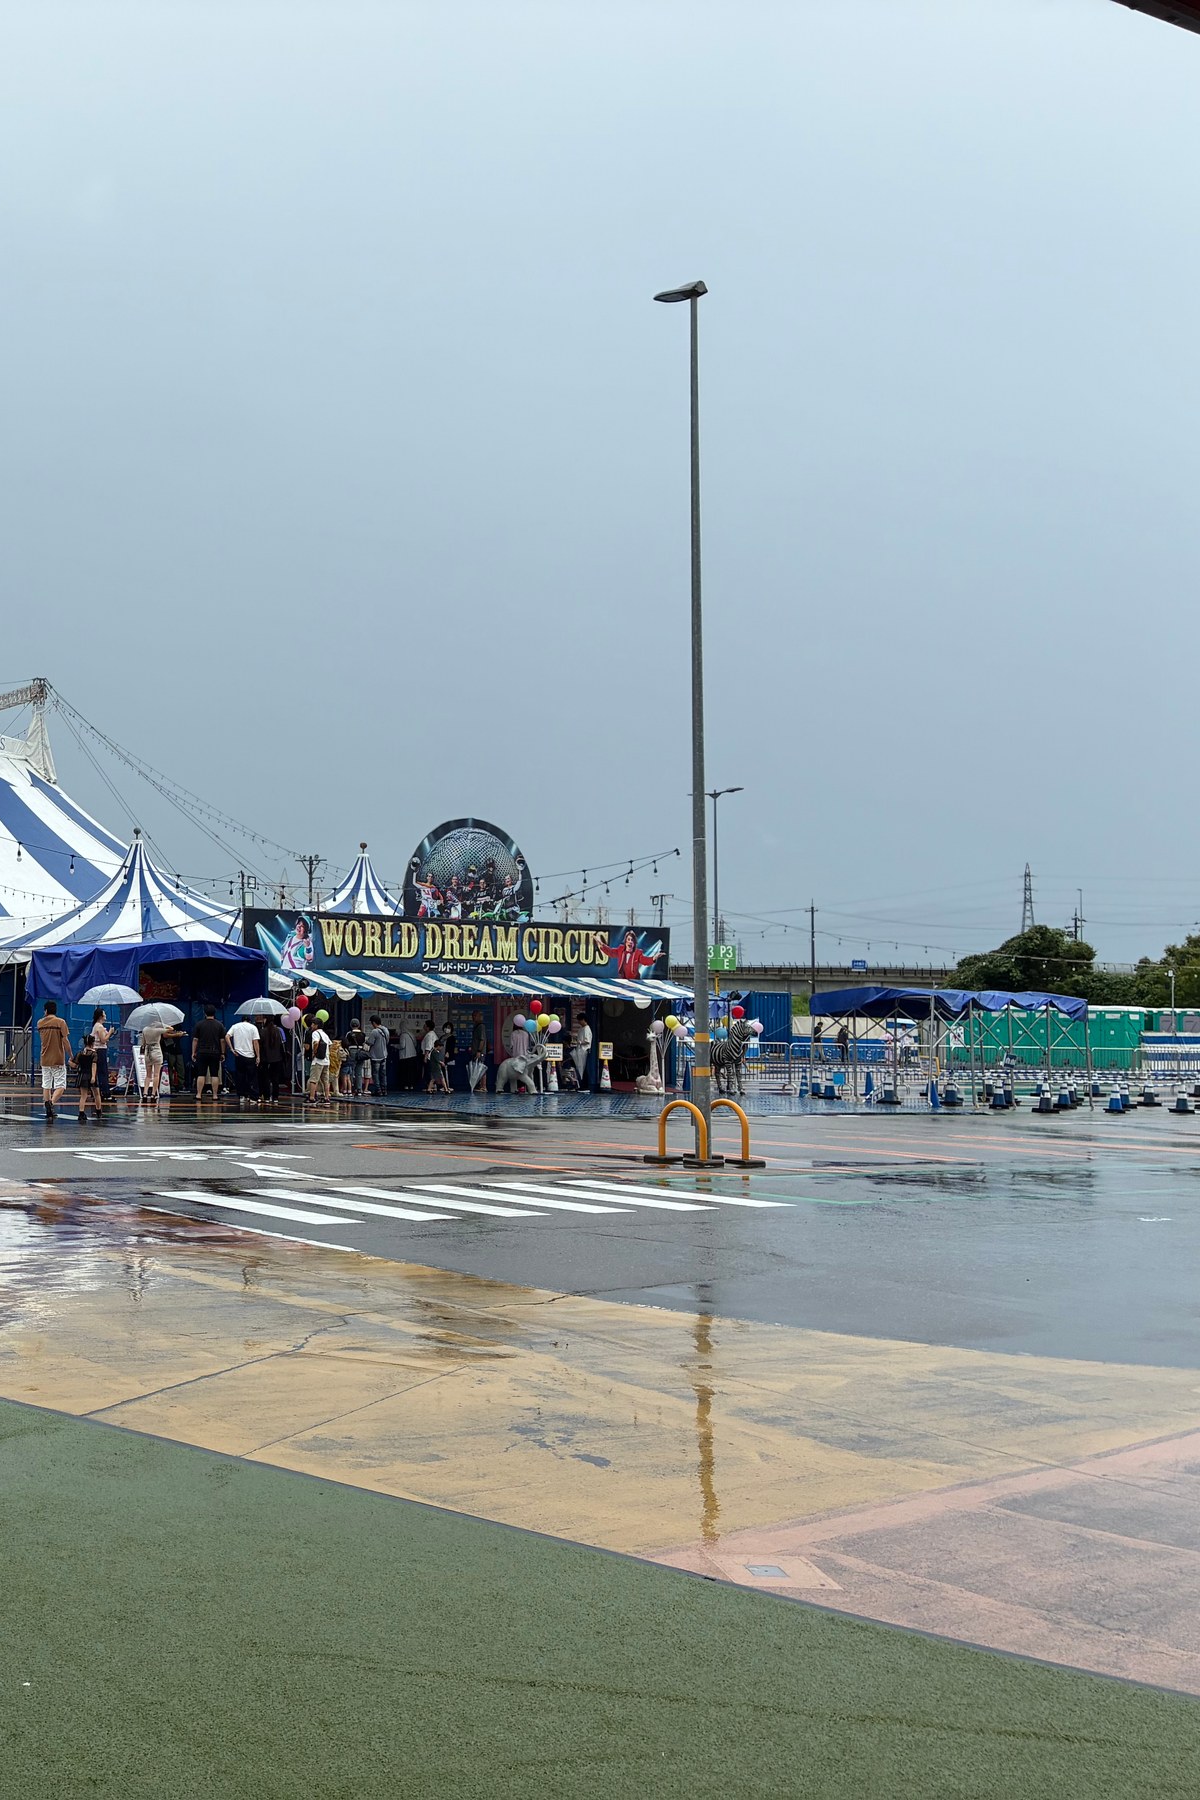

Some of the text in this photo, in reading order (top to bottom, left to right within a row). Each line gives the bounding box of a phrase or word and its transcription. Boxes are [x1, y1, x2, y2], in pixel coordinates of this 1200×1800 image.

[318, 918, 610, 965] WORLD DREAM CIRCUS
[720, 945, 733, 958] P3
[422, 962, 517, 974] ワールド・ドリームサーカス
[724, 959, 730, 969] E
